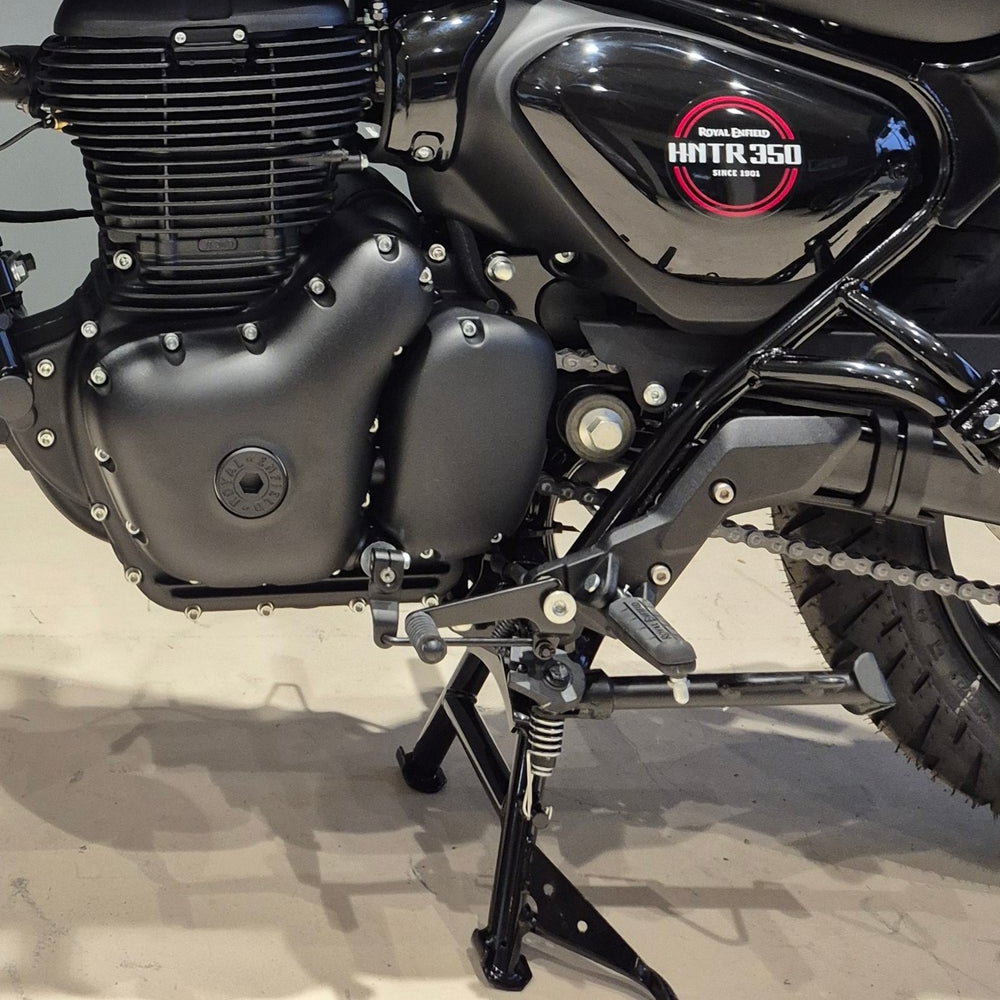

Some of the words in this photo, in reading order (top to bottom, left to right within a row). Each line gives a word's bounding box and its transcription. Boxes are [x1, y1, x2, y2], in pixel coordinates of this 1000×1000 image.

[698, 126, 731, 138] ROYAL
[731, 127, 771, 139] ENFIELD
[668, 142, 748, 164] HNTR
[749, 143, 802, 165] 350
[712, 169, 738, 177] SINCE
[740, 169, 760, 178] 1901
